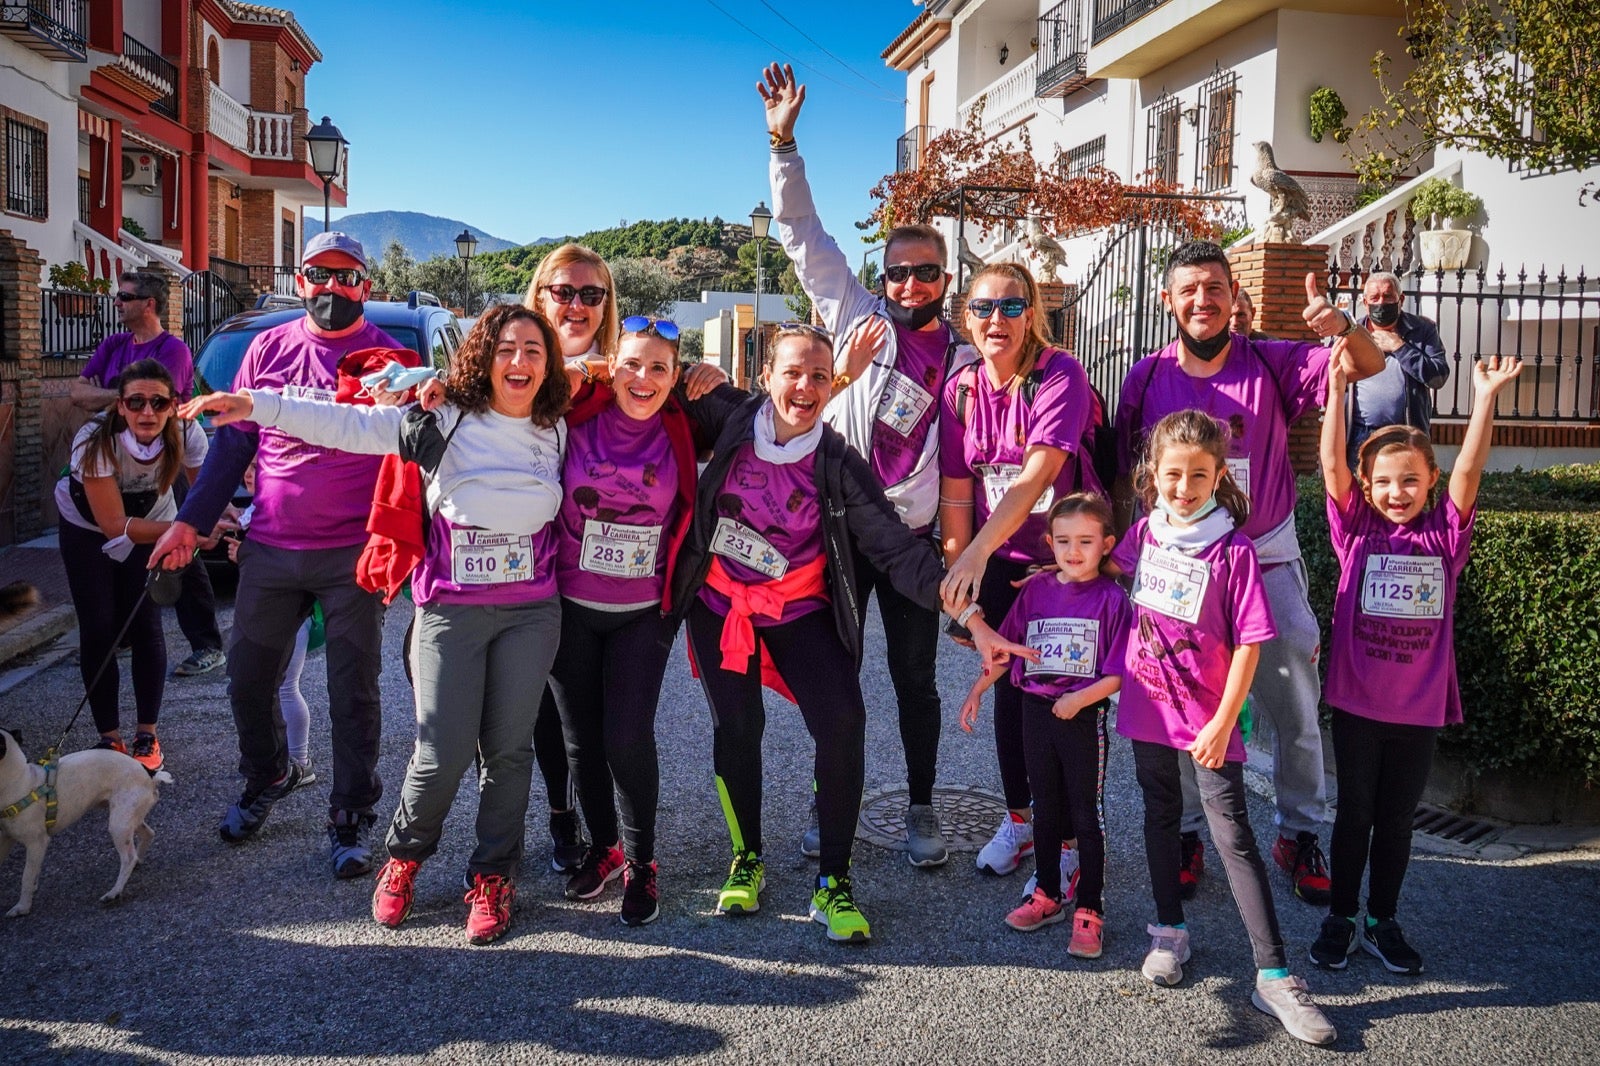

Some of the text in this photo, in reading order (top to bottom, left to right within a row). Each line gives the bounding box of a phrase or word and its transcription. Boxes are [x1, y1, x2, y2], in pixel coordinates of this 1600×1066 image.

[602, 523, 612, 536] V
[610, 532, 640, 540] CARRERA
[466, 532, 477, 544] V
[726, 534, 753, 555] 231
[592, 546, 625, 563] 283
[464, 556, 497, 572] 610
[1380, 556, 1388, 570] V
[1370, 582, 1414, 600] 1125
[1038, 620, 1046, 634] V
